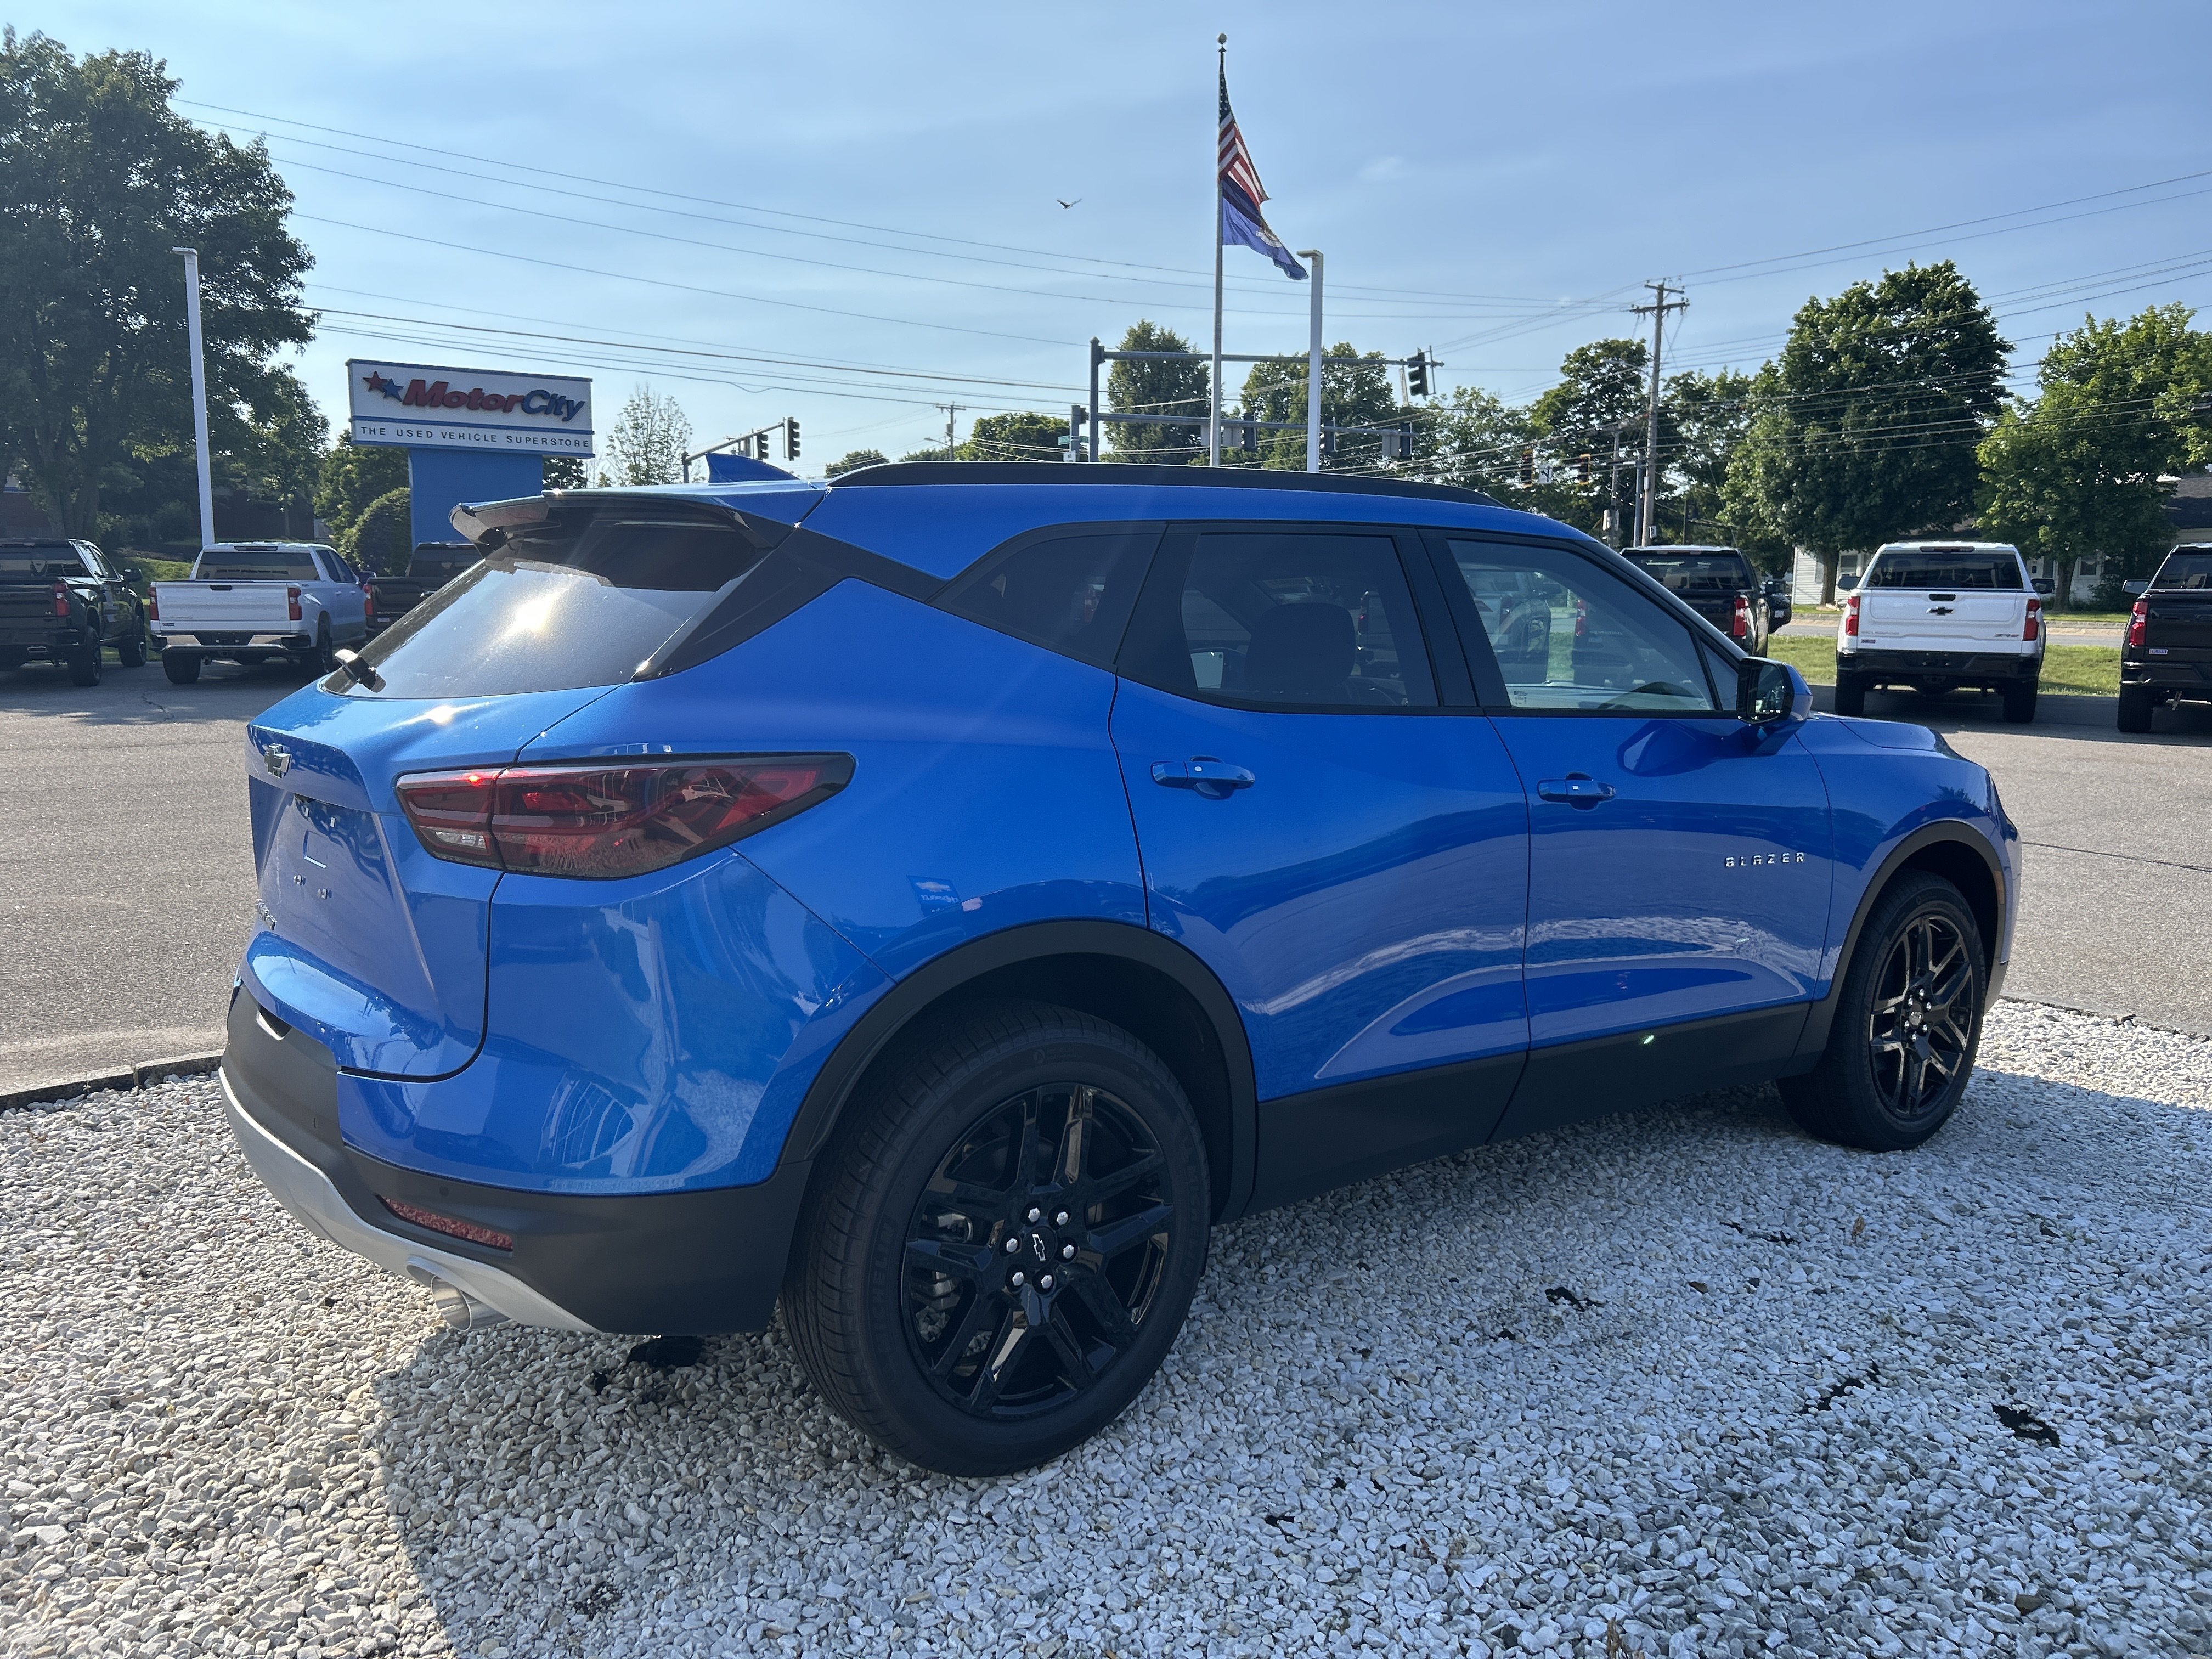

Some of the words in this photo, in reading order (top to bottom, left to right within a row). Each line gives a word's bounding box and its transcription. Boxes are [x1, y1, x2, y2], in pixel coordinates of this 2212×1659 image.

[402, 379, 586, 422] MotorCity
[360, 427, 386, 436] THE
[396, 429, 433, 438] USED
[441, 432, 497, 443] VEHICLE
[506, 436, 590, 448] SUPERSTORE
[1725, 852, 1804, 867] BLAZER
